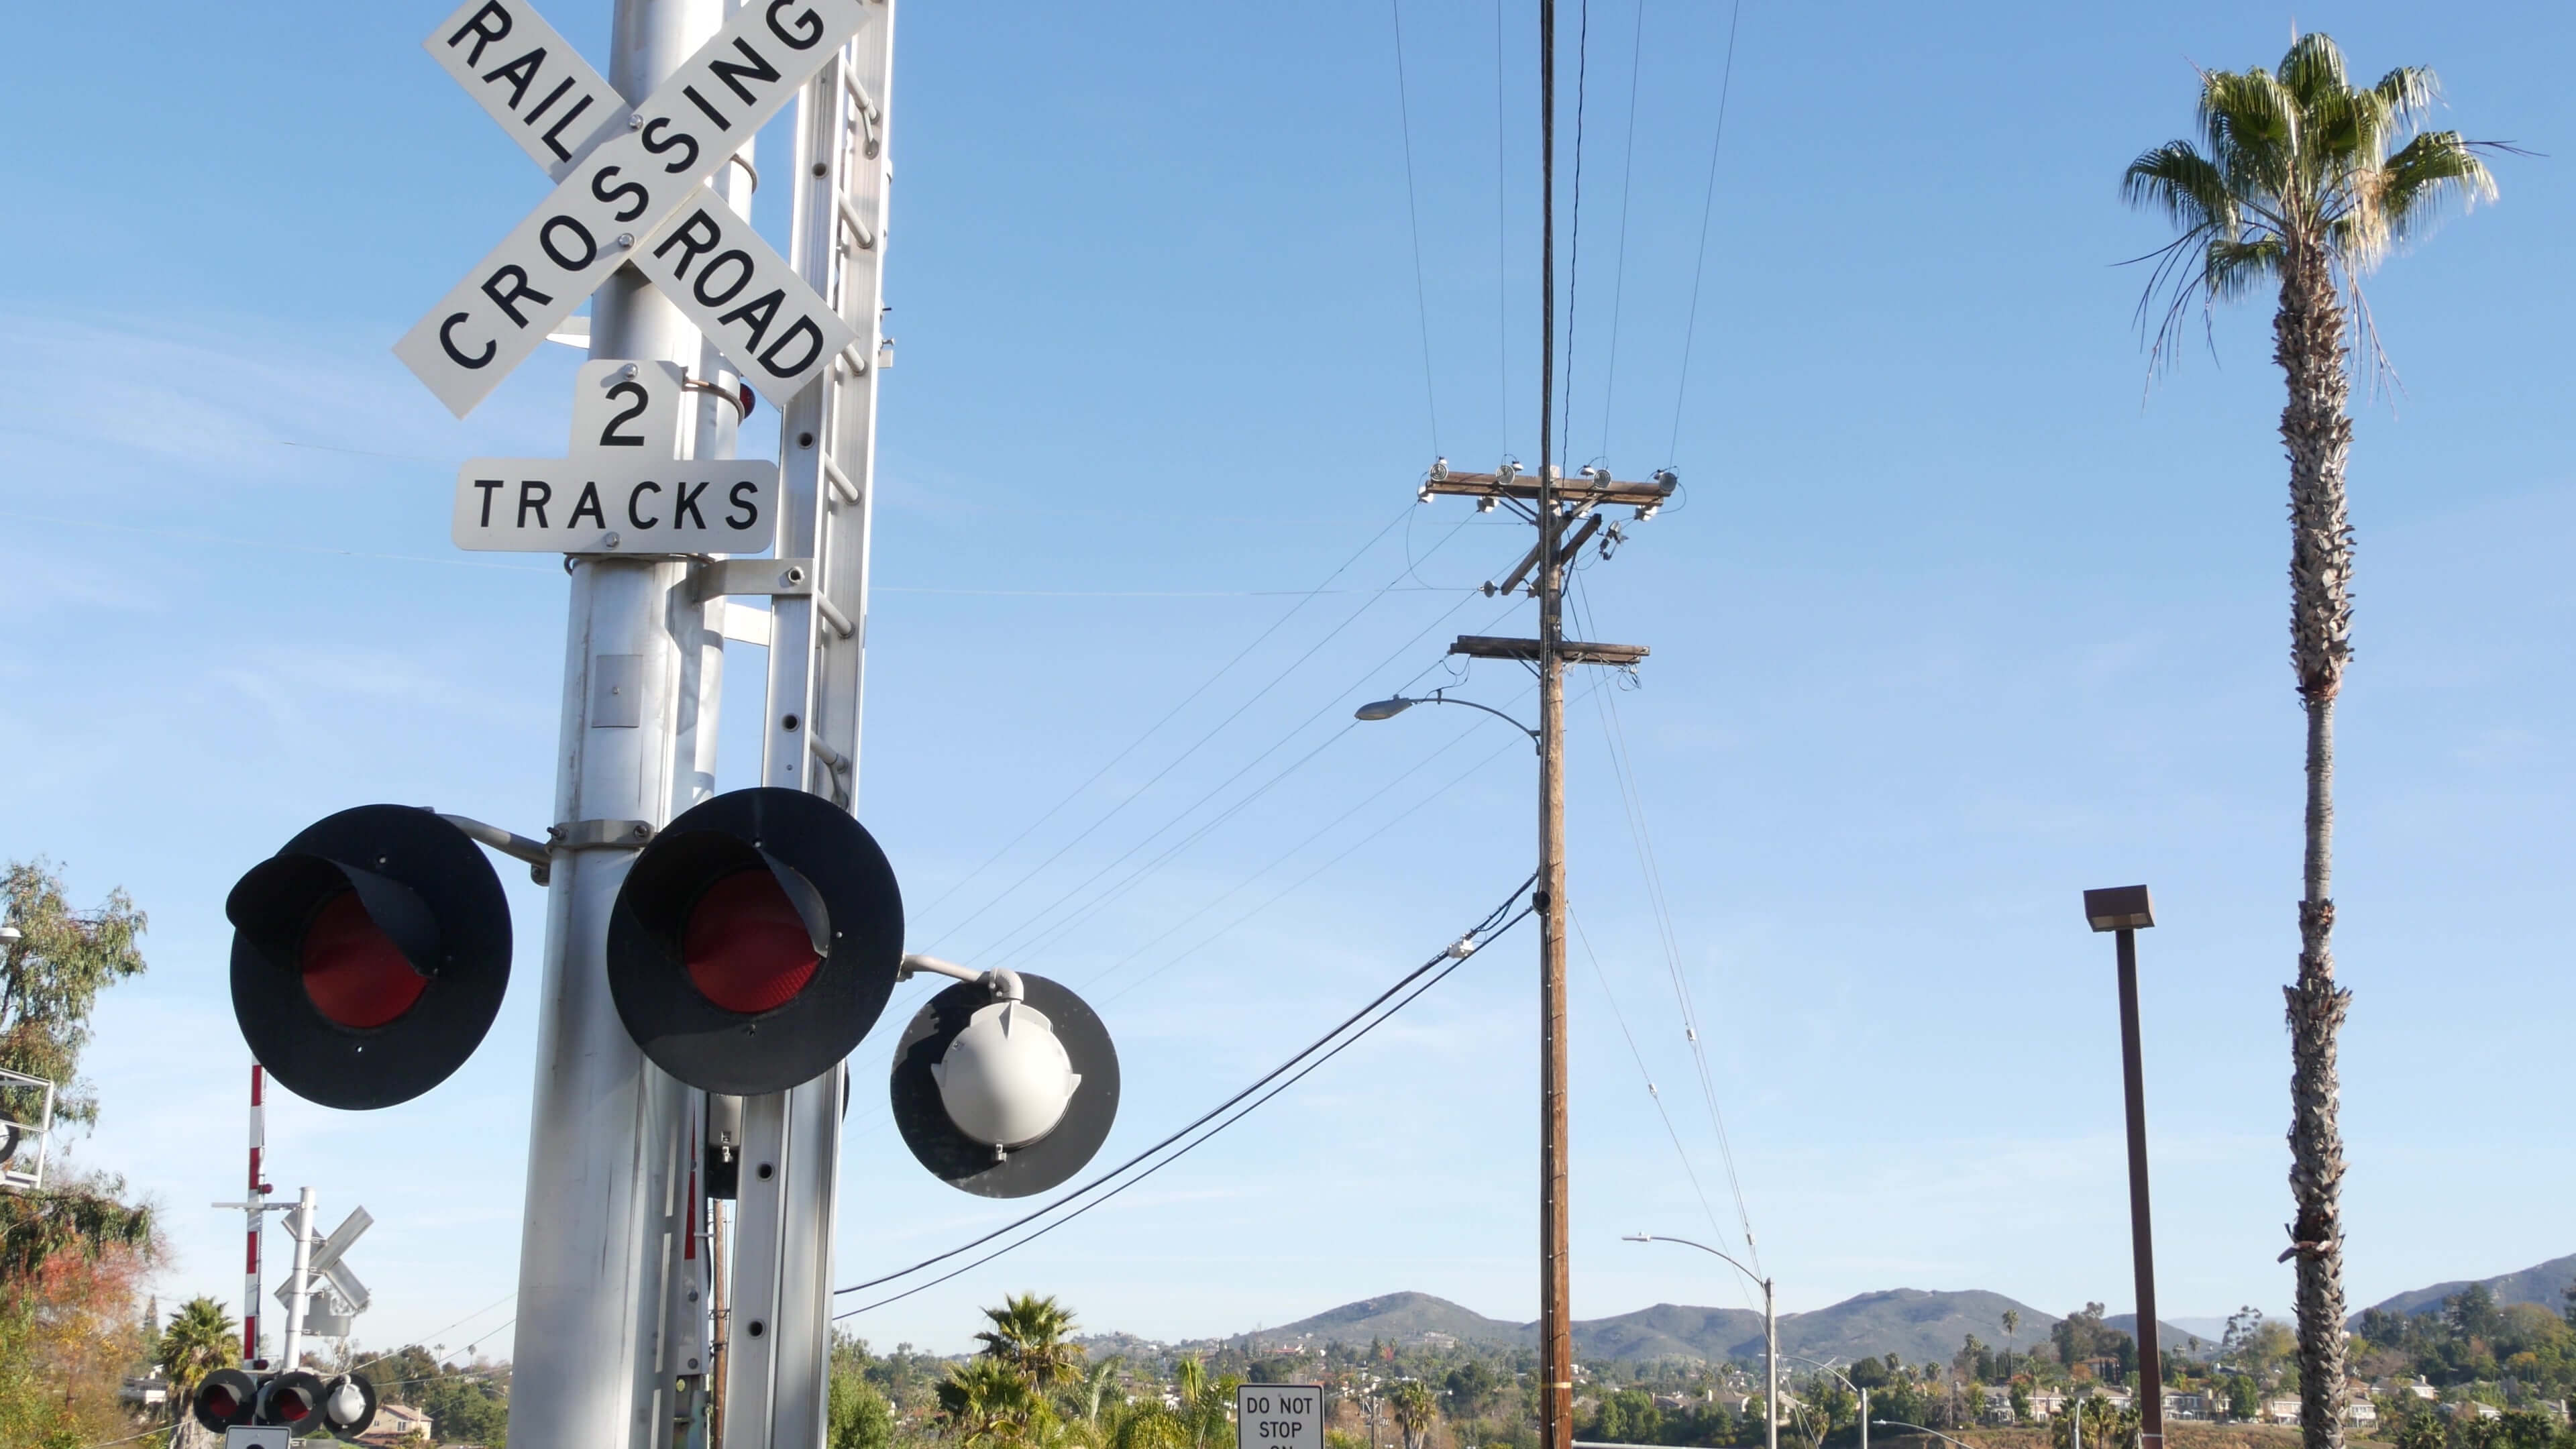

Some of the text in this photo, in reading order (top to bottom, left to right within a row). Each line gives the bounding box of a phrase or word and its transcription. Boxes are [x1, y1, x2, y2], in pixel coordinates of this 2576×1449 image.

[447, 0, 594, 162] RAIL
[439, 0, 824, 370] CROSSING
[653, 208, 823, 379] ROAD
[600, 381, 649, 447] 2
[474, 479, 759, 531] TRACKS
[1247, 1397, 1313, 1414] DO NOT
[1260, 1421, 1302, 1438] STOP
